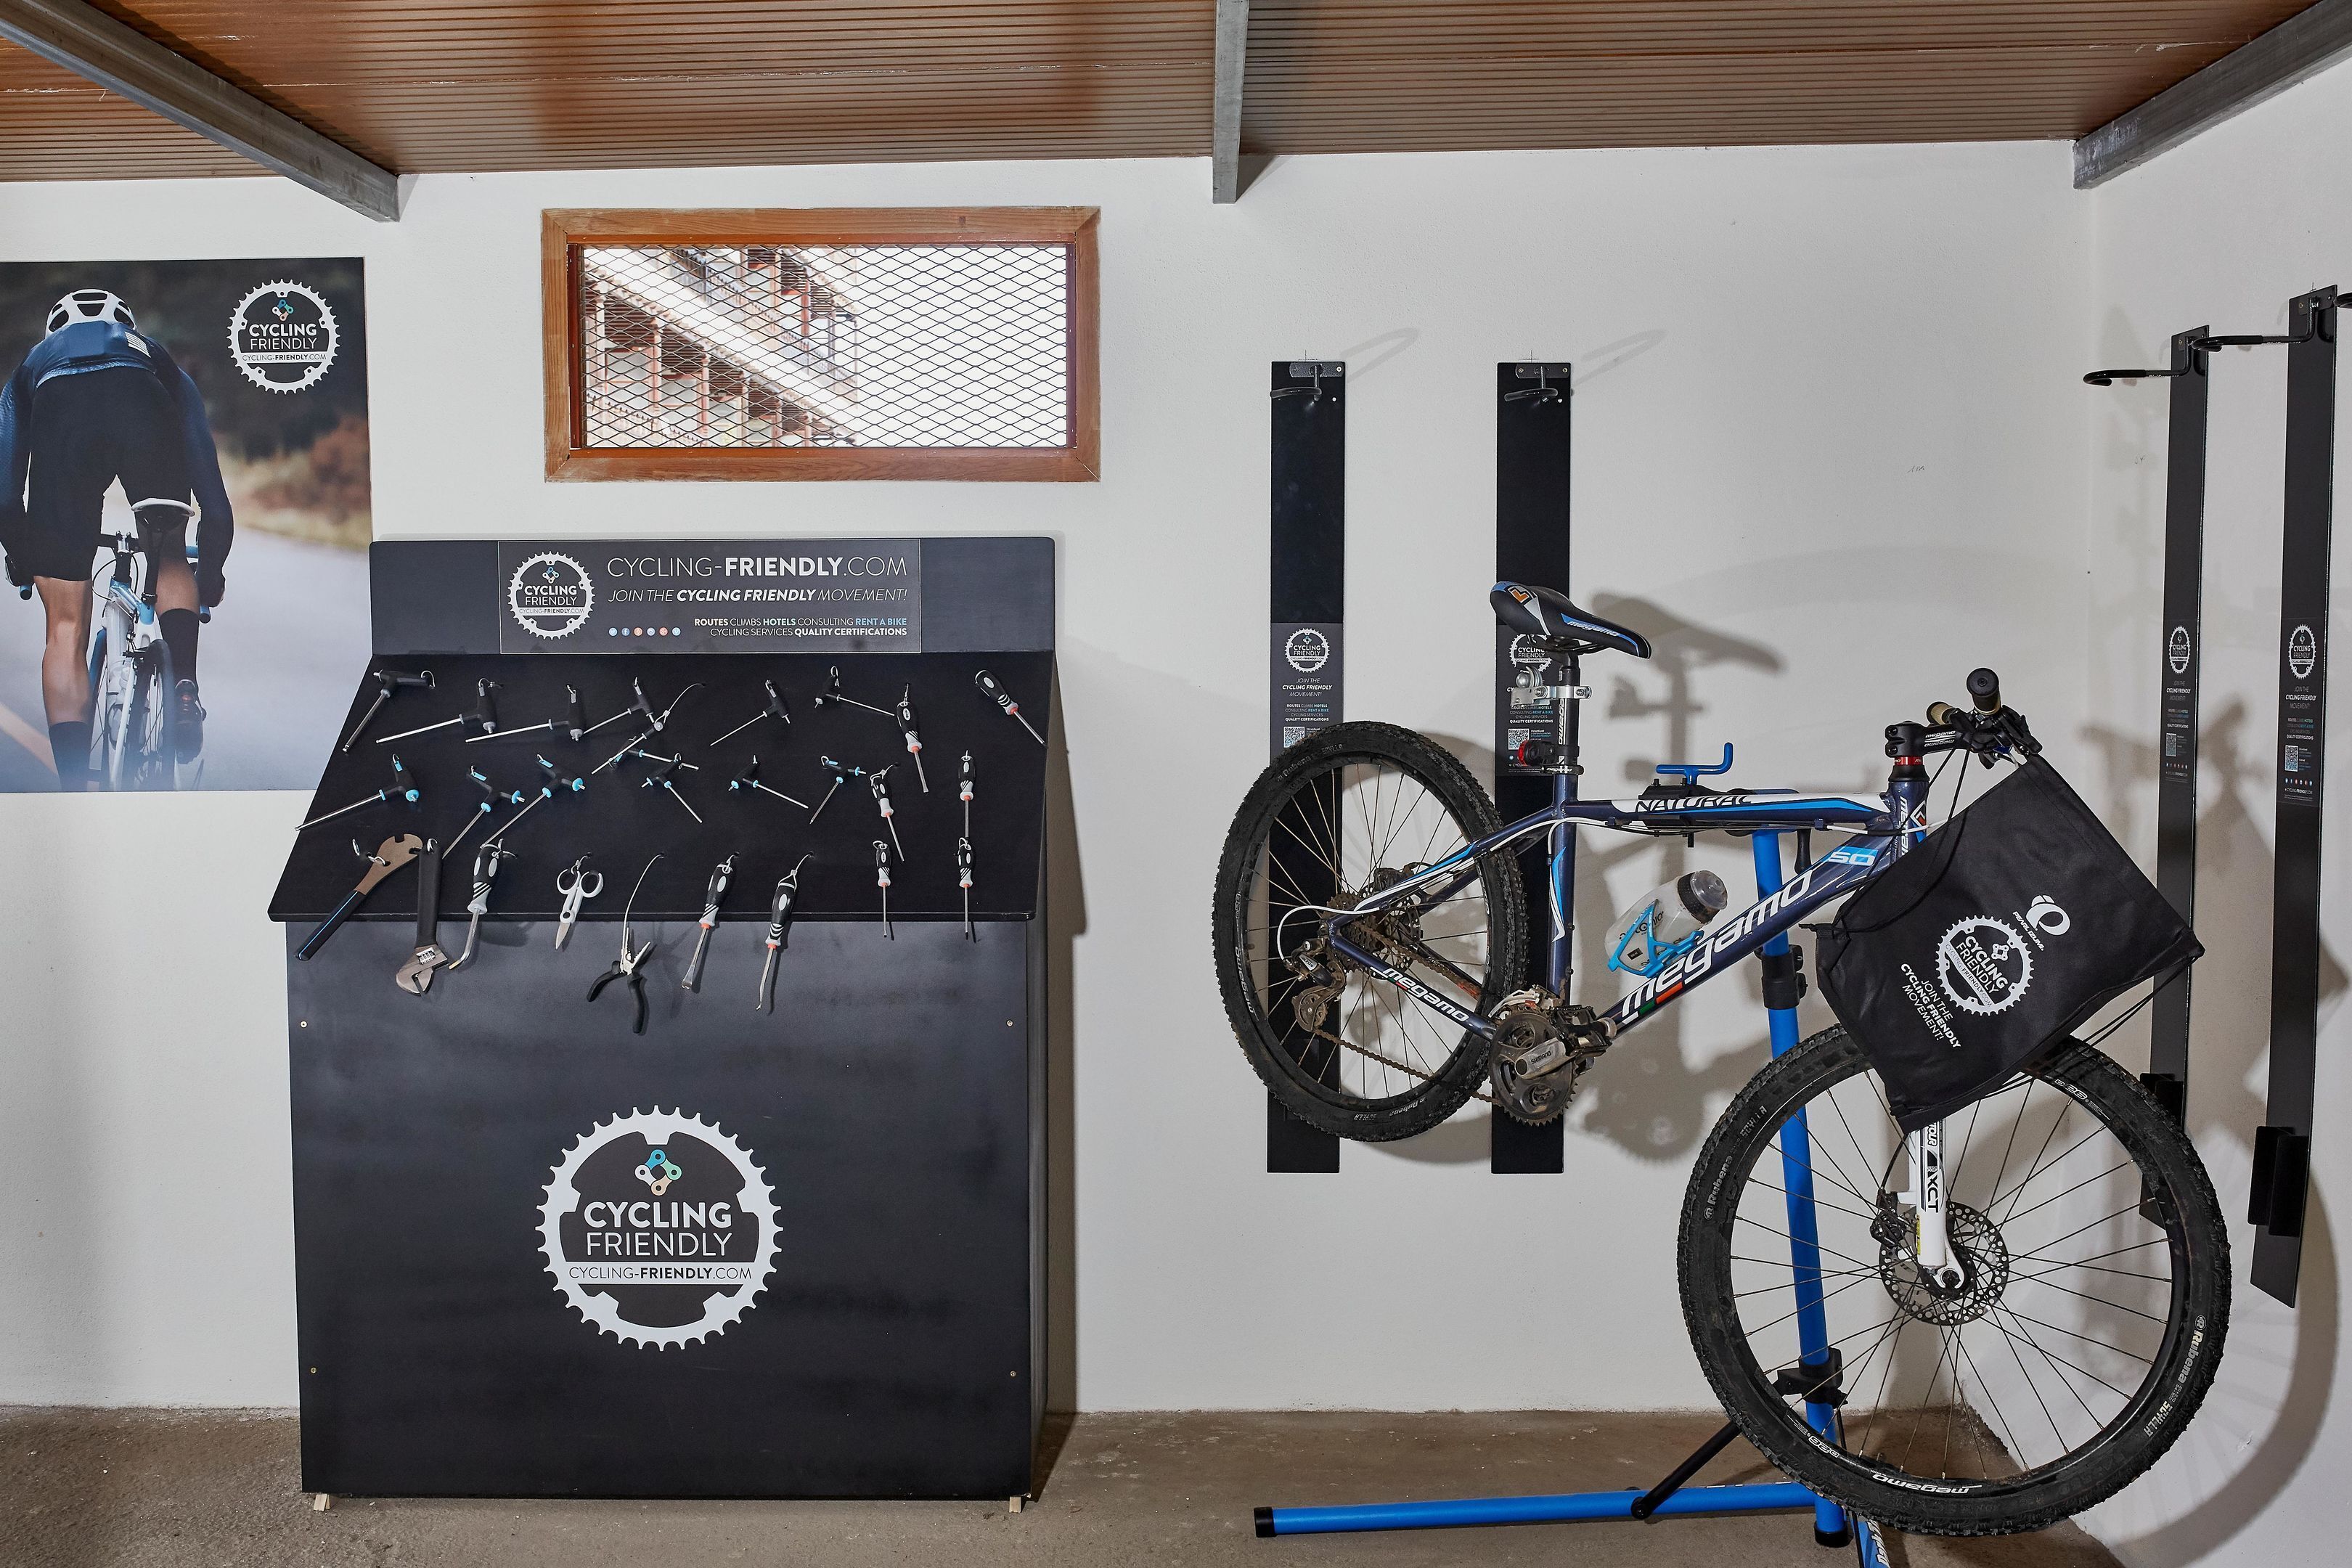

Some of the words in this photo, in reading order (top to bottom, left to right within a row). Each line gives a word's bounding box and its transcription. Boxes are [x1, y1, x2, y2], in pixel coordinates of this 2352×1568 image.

[249, 324, 317, 337] CYCLING
[250, 338, 317, 350] FRIENDLY
[607, 557, 907, 578] CYCLING-FRIENDLY.COM
[524, 585, 577, 595] CYCLING
[525, 596, 577, 605] FRIENDLY
[608, 589, 644, 602] JOIN
[648, 589, 674, 601] THE
[677, 589, 740, 602] CYCLING
[743, 589, 817, 601] FRIENDLY
[817, 589, 907, 601] MOVEMENT!
[694, 618, 728, 626] ROUTES
[730, 618, 761, 626] CLIMBS
[763, 618, 796, 626] HOTELS
[797, 618, 854, 626] CONSULTING
[710, 627, 749, 637] CYCLING
[751, 627, 793, 636] SERVICES
[794, 627, 833, 637] QUALITY
[834, 627, 907, 636] CERTIFICATIONS
[1567, 621, 1621, 637] megamo
[1635, 795, 1755, 813] NATURAL
[2012, 911, 2030, 932] PEARL
[2028, 931, 2045, 949] IZUMI
[1621, 870, 1813, 1018] megamo
[1956, 942, 1999, 994] FRIENDLY
[1965, 936, 2009, 989] CYCLING
[1945, 944, 1992, 1007] CYCLING-FRIENDLY.COM
[1382, 968, 1470, 1022] megamo
[1900, 963, 1931, 1005] CYCLING
[1926, 1004, 1961, 1048] FRIENDLY
[1921, 980, 1941, 1003] JOIN
[1935, 1000, 1953, 1020] THE
[1902, 984, 1944, 1041] MOVEMENT!
[1530, 1050, 1551, 1065] SHIMANO
[1707, 1155, 1734, 1205] Rubena
[1927, 1174, 1939, 1213] XCT
[584, 1201, 732, 1228] CYCLING
[587, 1232, 732, 1257] FRIENDLY
[568, 1267, 752, 1280] CYCLING-FRIENDLY.COM
[2177, 1329, 2204, 1384] Rubena
[1872, 1474, 1970, 1495] megamo
